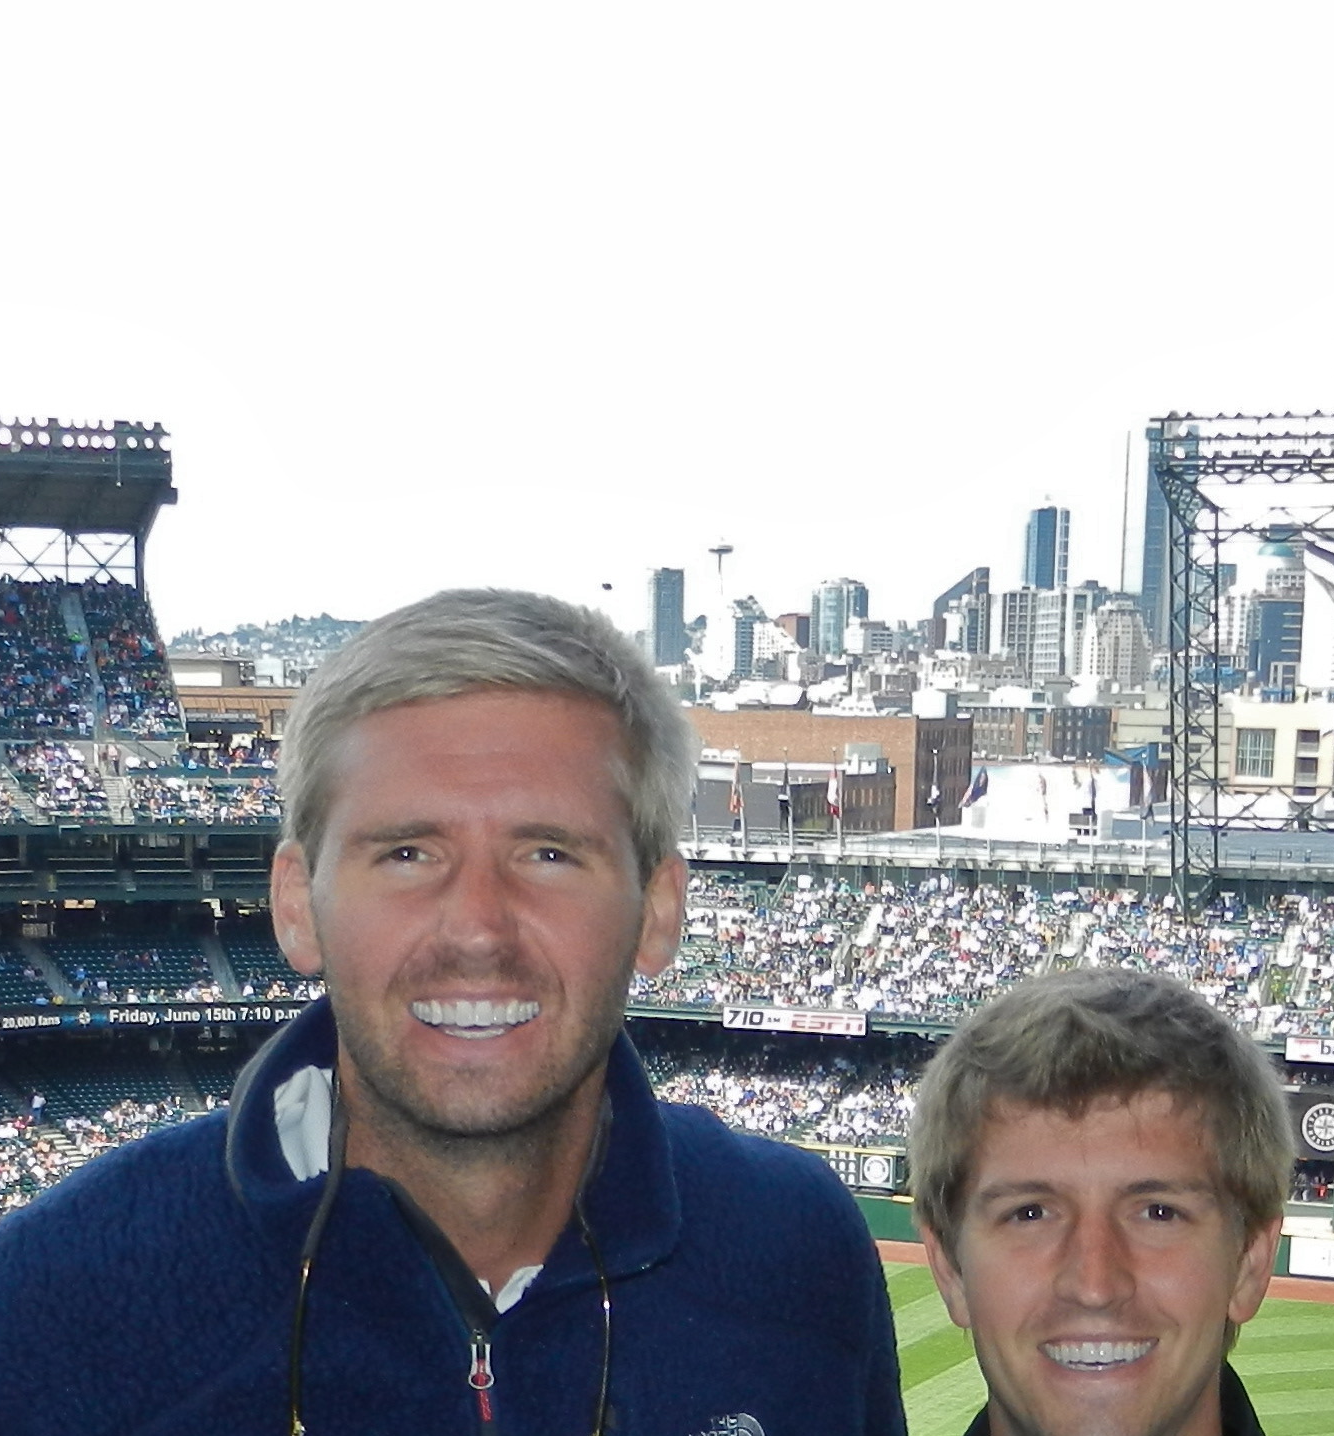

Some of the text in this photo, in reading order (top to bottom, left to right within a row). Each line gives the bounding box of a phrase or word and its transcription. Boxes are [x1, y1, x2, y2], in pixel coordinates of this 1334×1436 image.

[3, 1016, 36, 1030] 20,000
[38, 1015, 60, 1027] fans
[109, 1009, 160, 1026] Friday,
[164, 1008, 201, 1023] June
[205, 1007, 236, 1021] 15th
[240, 1007, 271, 1021] 7:10
[728, 1009, 764, 1026] 710
[791, 1013, 864, 1032] ESPN
